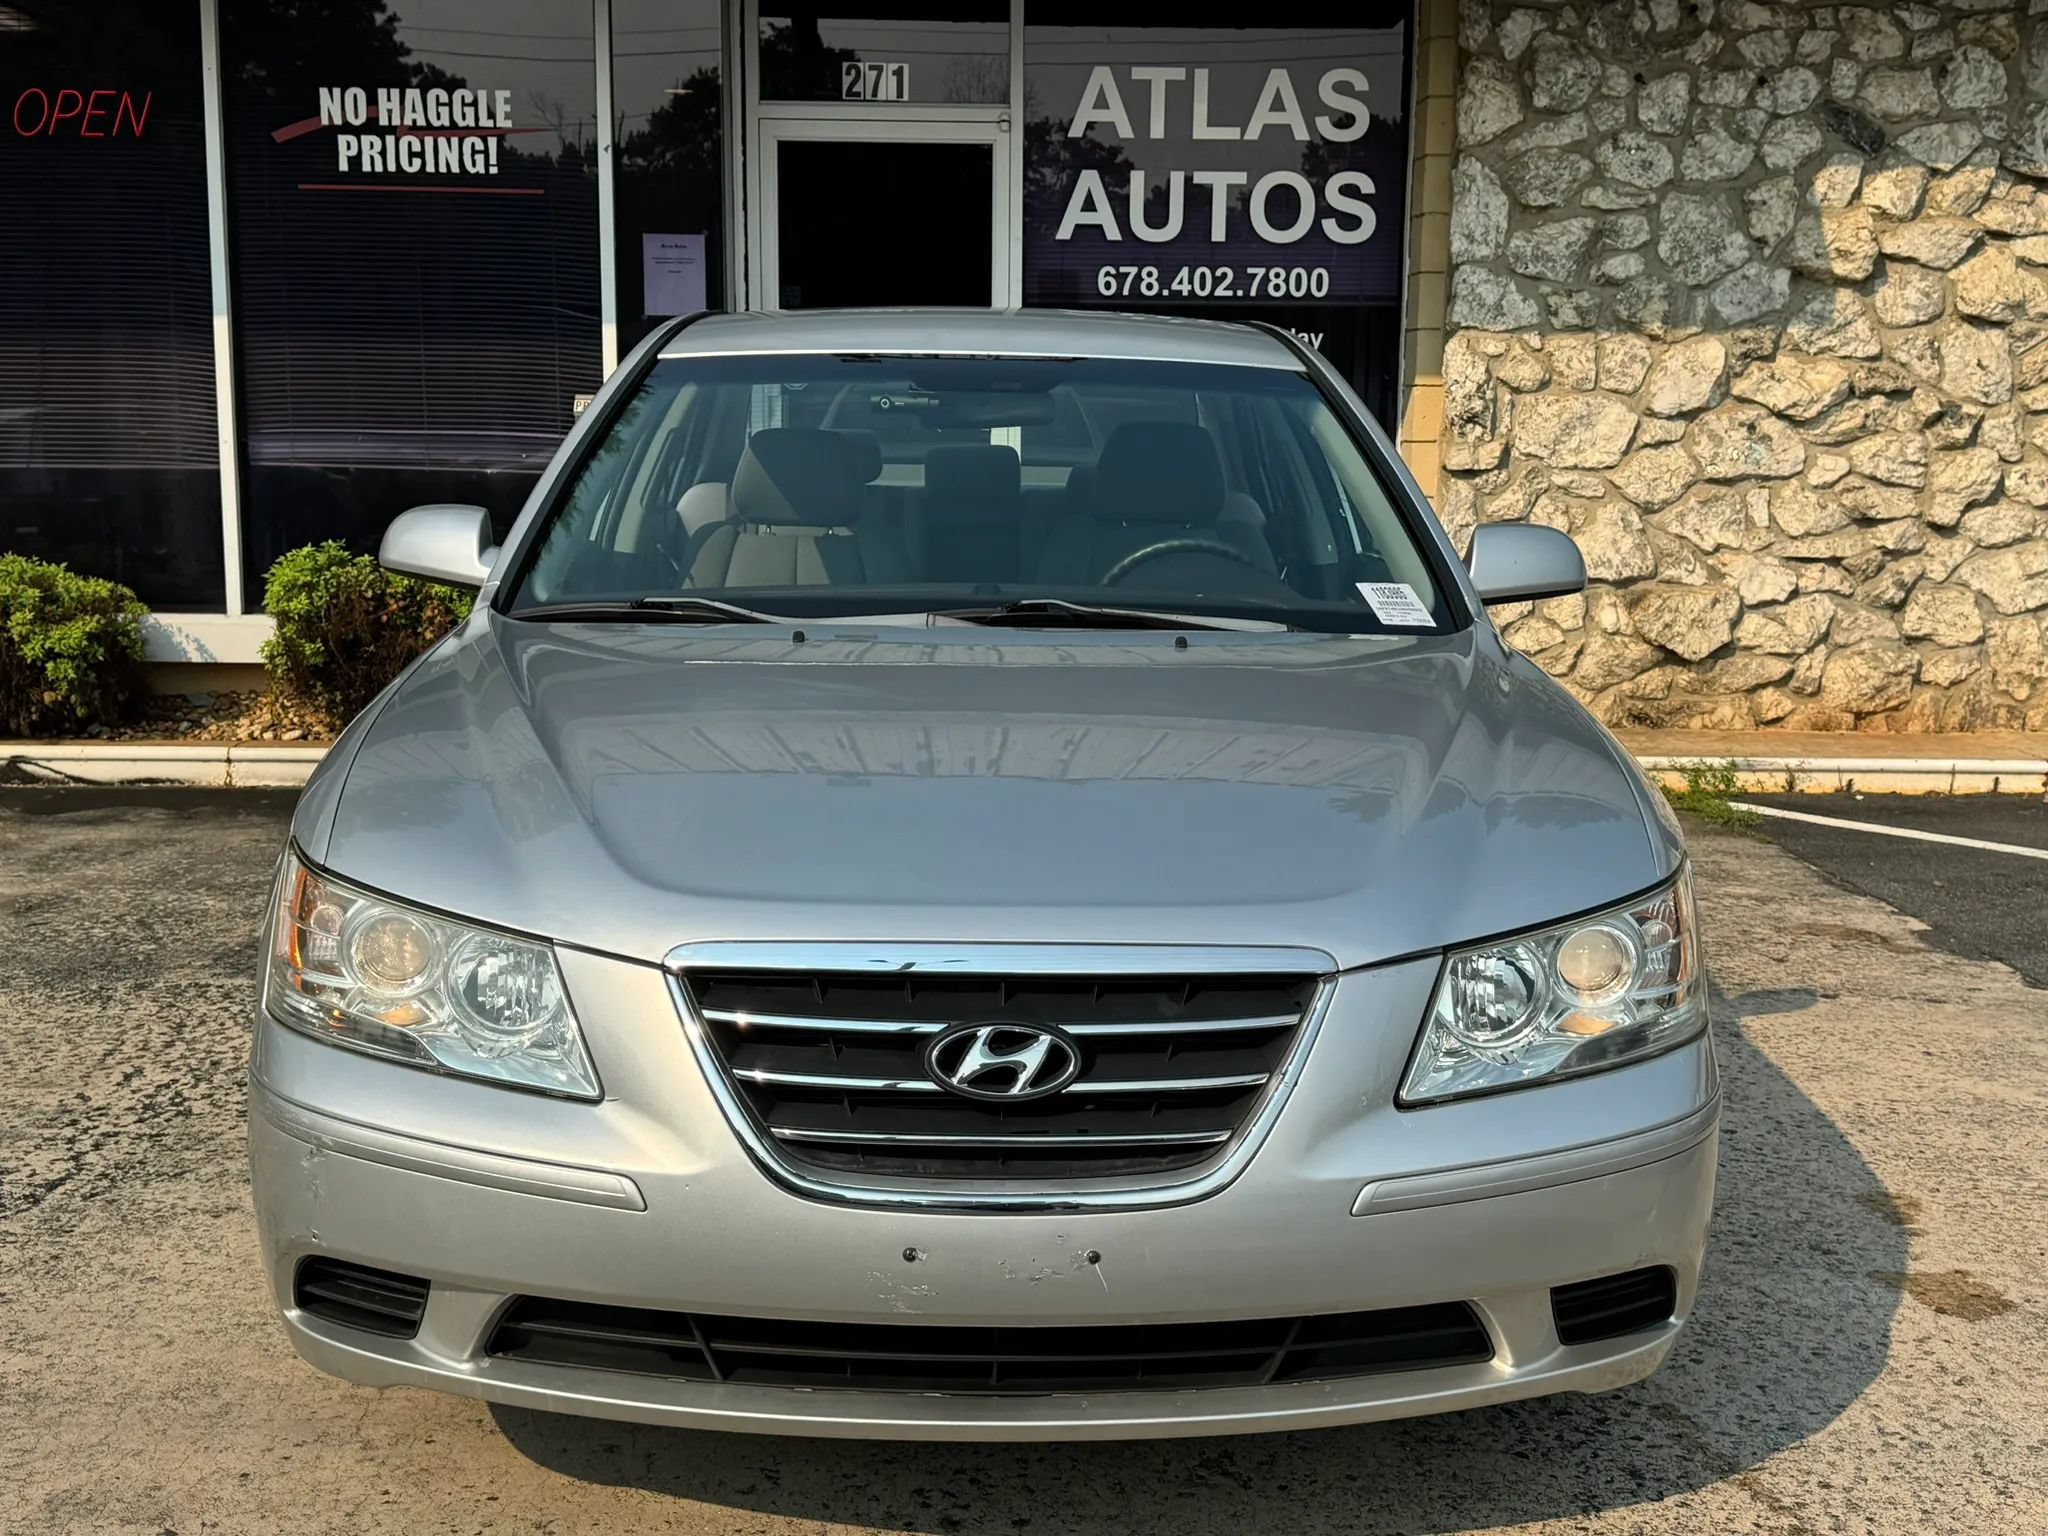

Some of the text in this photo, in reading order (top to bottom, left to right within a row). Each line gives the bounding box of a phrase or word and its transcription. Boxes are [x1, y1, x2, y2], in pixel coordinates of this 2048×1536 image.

[844, 63, 905, 100] 271
[13, 87, 152, 138] OPEN
[319, 87, 514, 129] NO HAGGLE
[1067, 67, 1370, 142] ATLAS
[337, 134, 499, 175] PRICING!
[1055, 169, 1377, 244] AUTOS
[1097, 265, 1330, 298] 678.402.7800
[1291, 328, 1324, 351] ay
